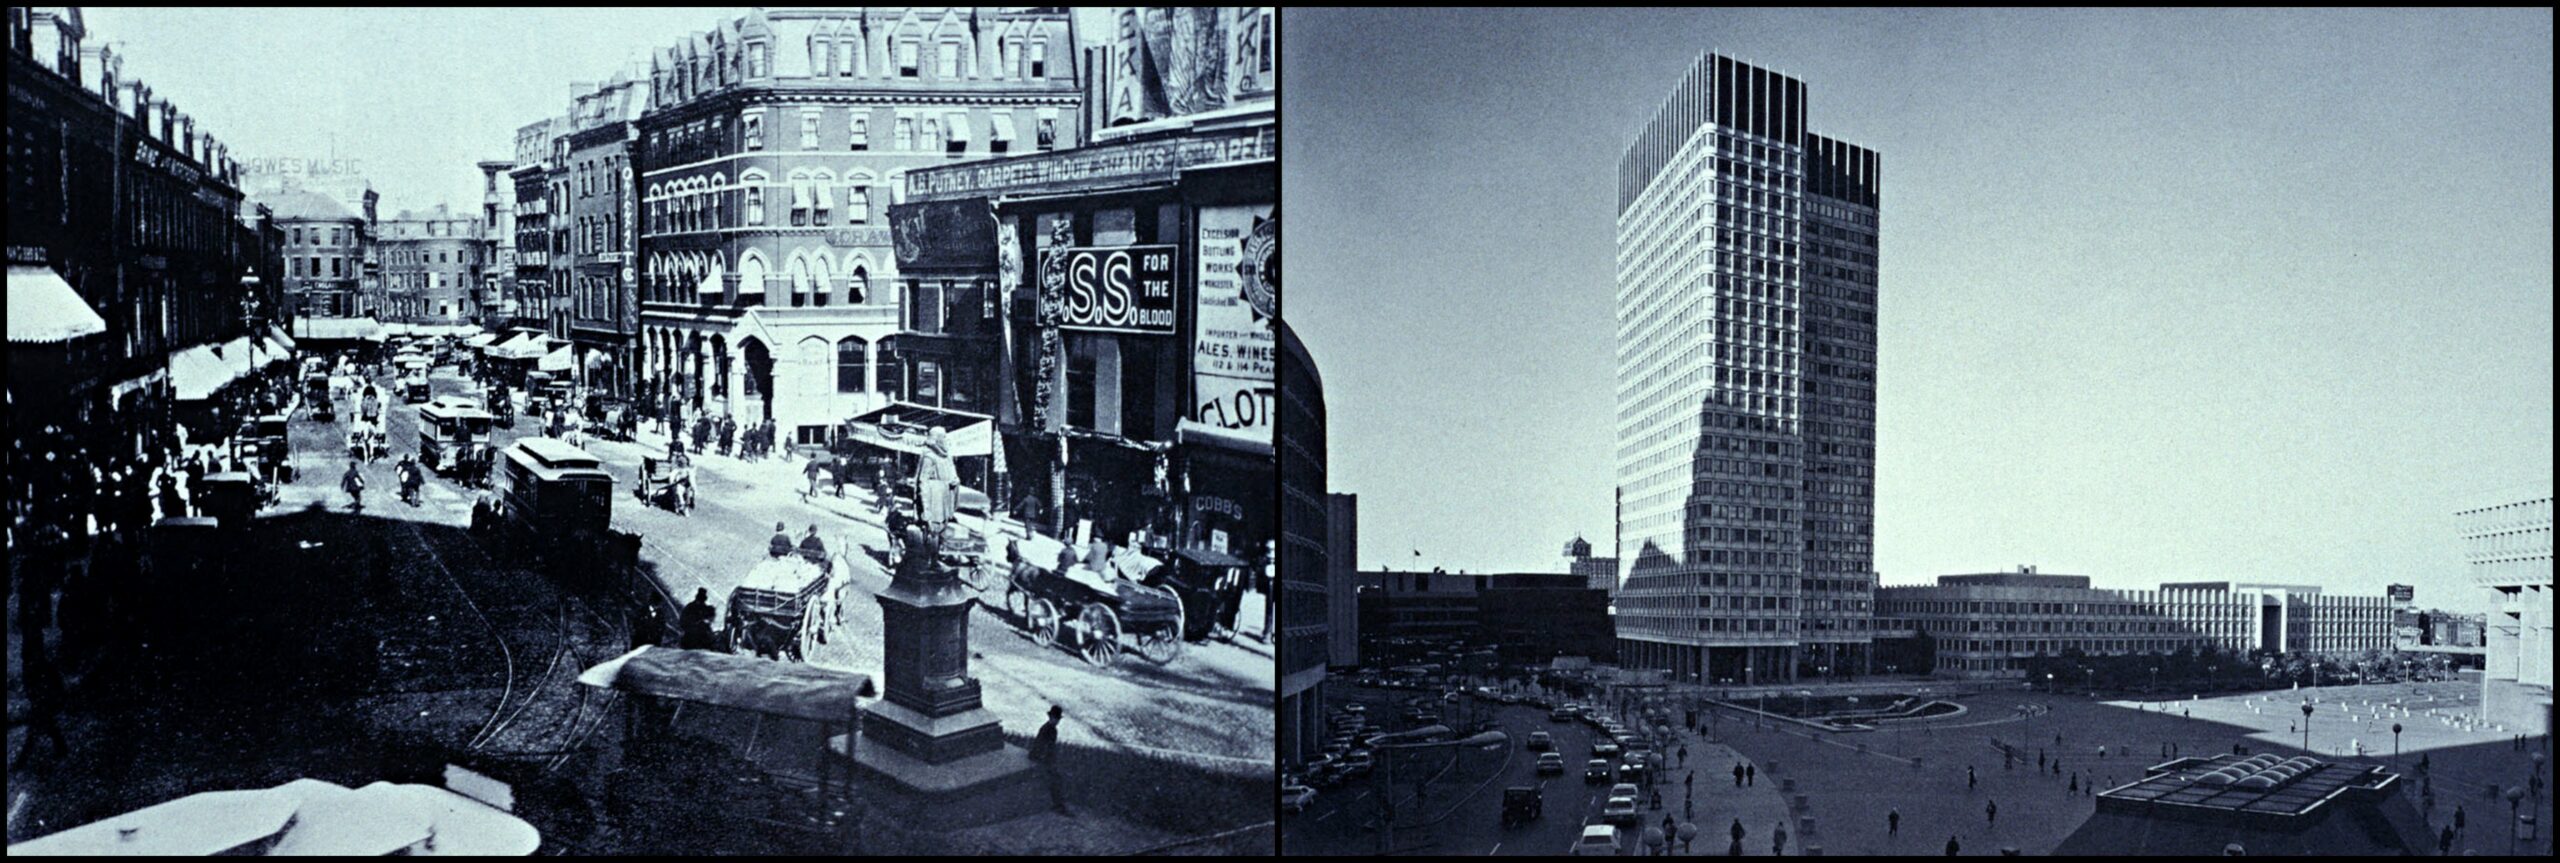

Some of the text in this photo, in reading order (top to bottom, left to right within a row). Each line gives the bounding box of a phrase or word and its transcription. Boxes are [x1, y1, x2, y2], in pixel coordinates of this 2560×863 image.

[307, 157, 362, 177] MUSIC
[1143, 254, 1169, 271] FOR
[1206, 263, 1234, 273] WORKS
[1143, 280, 1169, 297] THE
[1139, 308, 1172, 326] BLOOD
